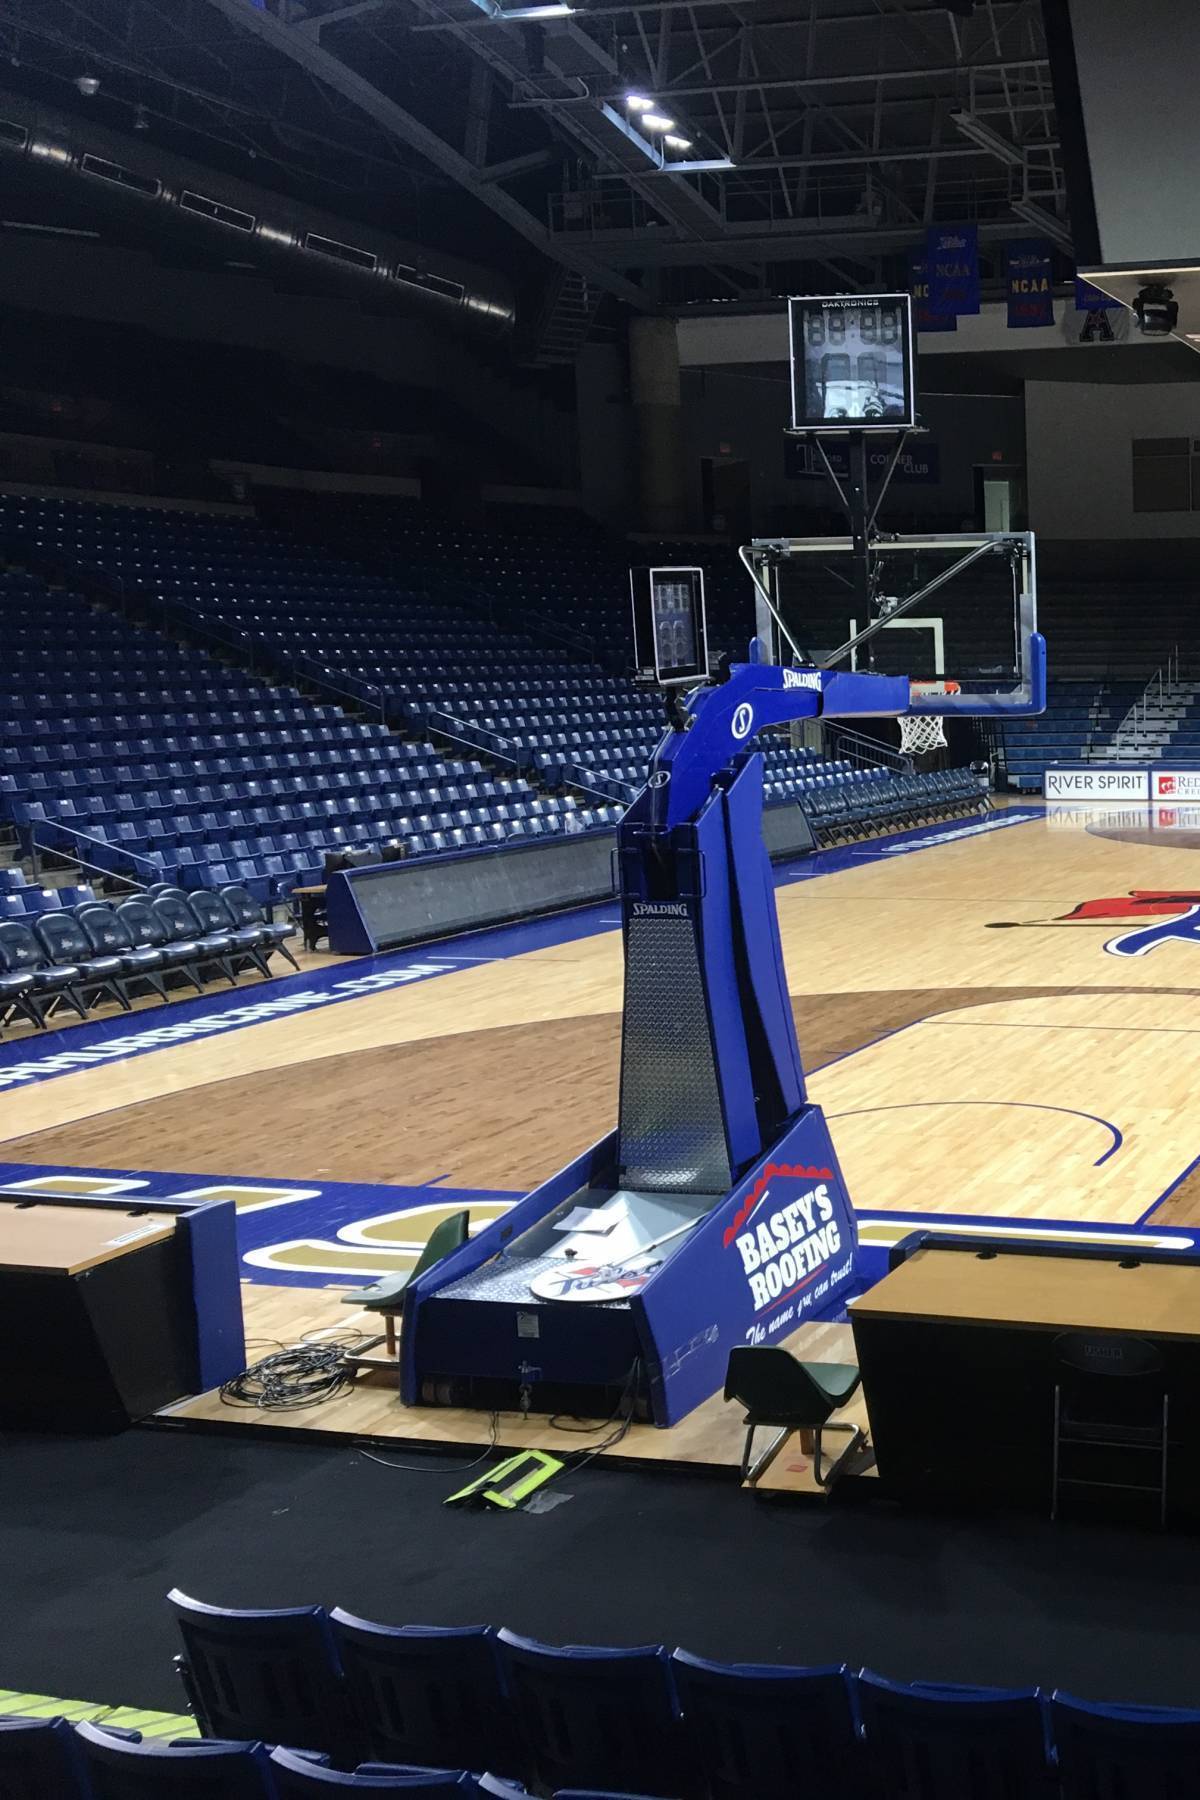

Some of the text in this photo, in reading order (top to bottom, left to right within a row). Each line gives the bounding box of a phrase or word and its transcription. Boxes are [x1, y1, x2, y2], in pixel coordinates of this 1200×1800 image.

[1011, 277, 1049, 294] NCAA
[903, 464, 929, 475] CLUB
[782, 668, 822, 692] SPALDING
[1048, 775, 1143, 794] RIVER SPIRIT
[633, 902, 688, 918] SPALDING
[735, 1184, 833, 1276] BASEY'S
[748, 1220, 841, 1312] ROOFING
[745, 1321, 767, 1347] The
[768, 1306, 795, 1334] name
[814, 1281, 829, 1303] can
[830, 1251, 854, 1287] trust!
